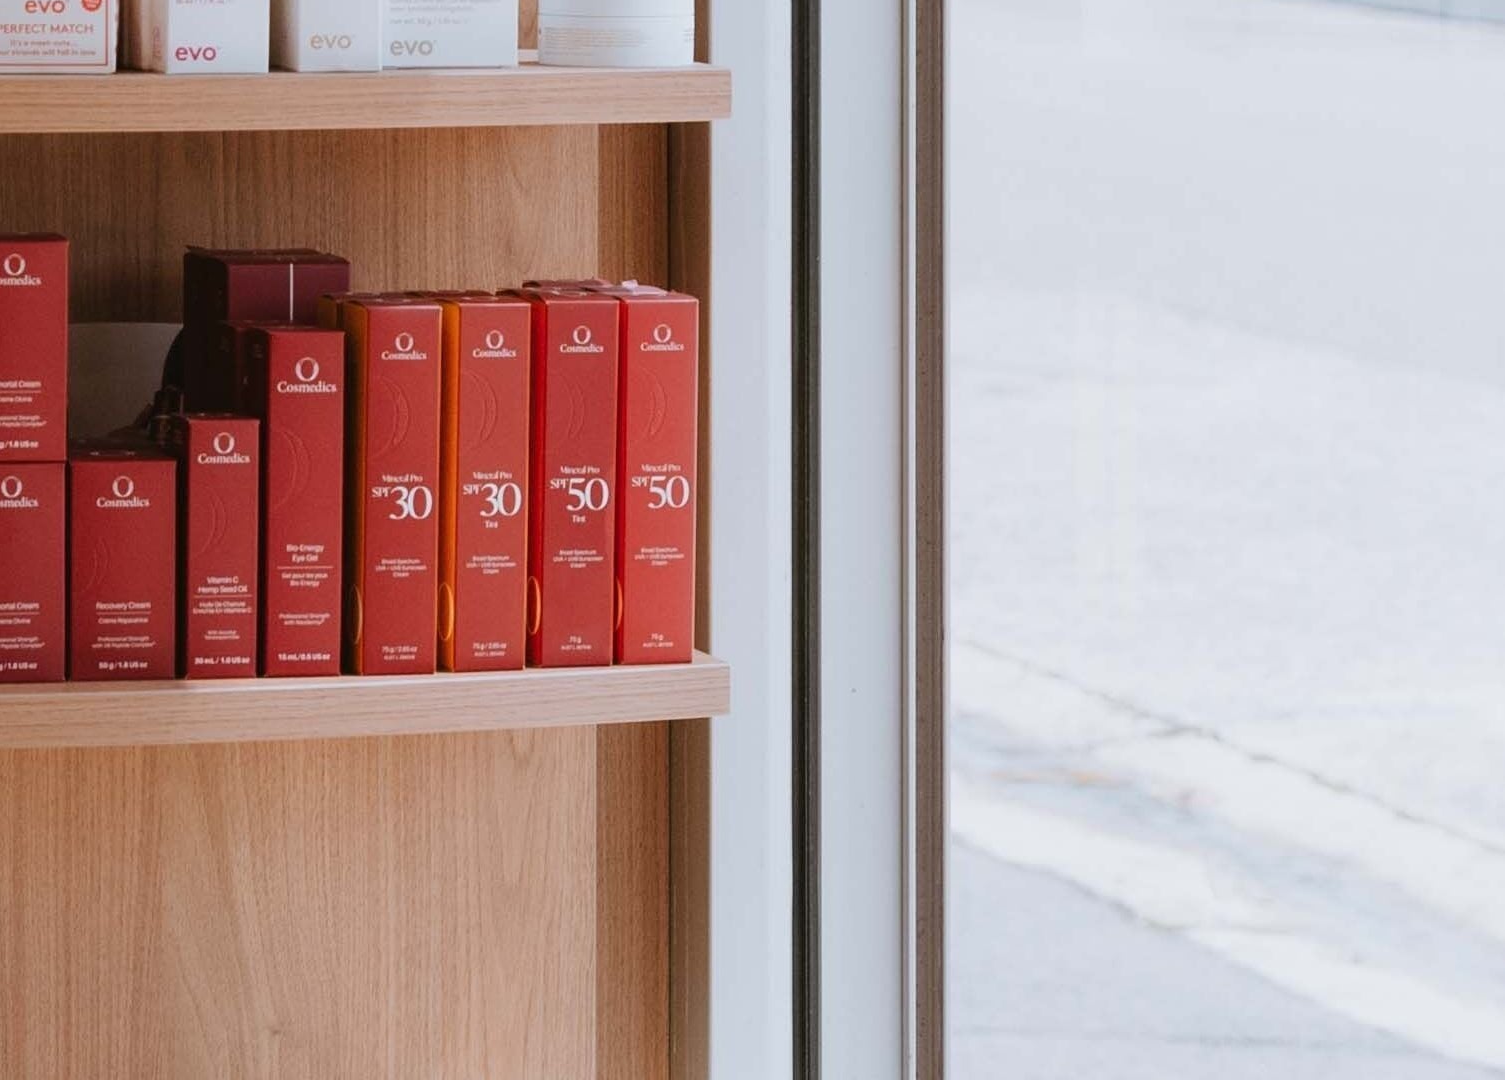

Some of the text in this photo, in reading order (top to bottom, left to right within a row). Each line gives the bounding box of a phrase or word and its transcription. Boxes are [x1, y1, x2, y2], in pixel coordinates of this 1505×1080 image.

[25, 0, 66, 14] evo
[50, 24, 94, 34] MATCH
[310, 34, 352, 50] evo
[390, 40, 433, 56] evo
[175, 47, 216, 61] evo
[560, 343, 604, 353] Cosmedics
[640, 341, 684, 351] Cosmedics
[381, 350, 427, 360] Cosmedics
[472, 348, 516, 358] Cosmedics
[277, 380, 337, 393] Cosmedics
[197, 453, 250, 464] Cosmedics
[566, 478, 609, 511] 50
[647, 476, 690, 509] 50
[96, 497, 150, 507] Cosmedics
[388, 486, 433, 520] 30
[479, 483, 522, 517] 30
[485, 520, 498, 528] Tint
[572, 515, 586, 523] Tint
